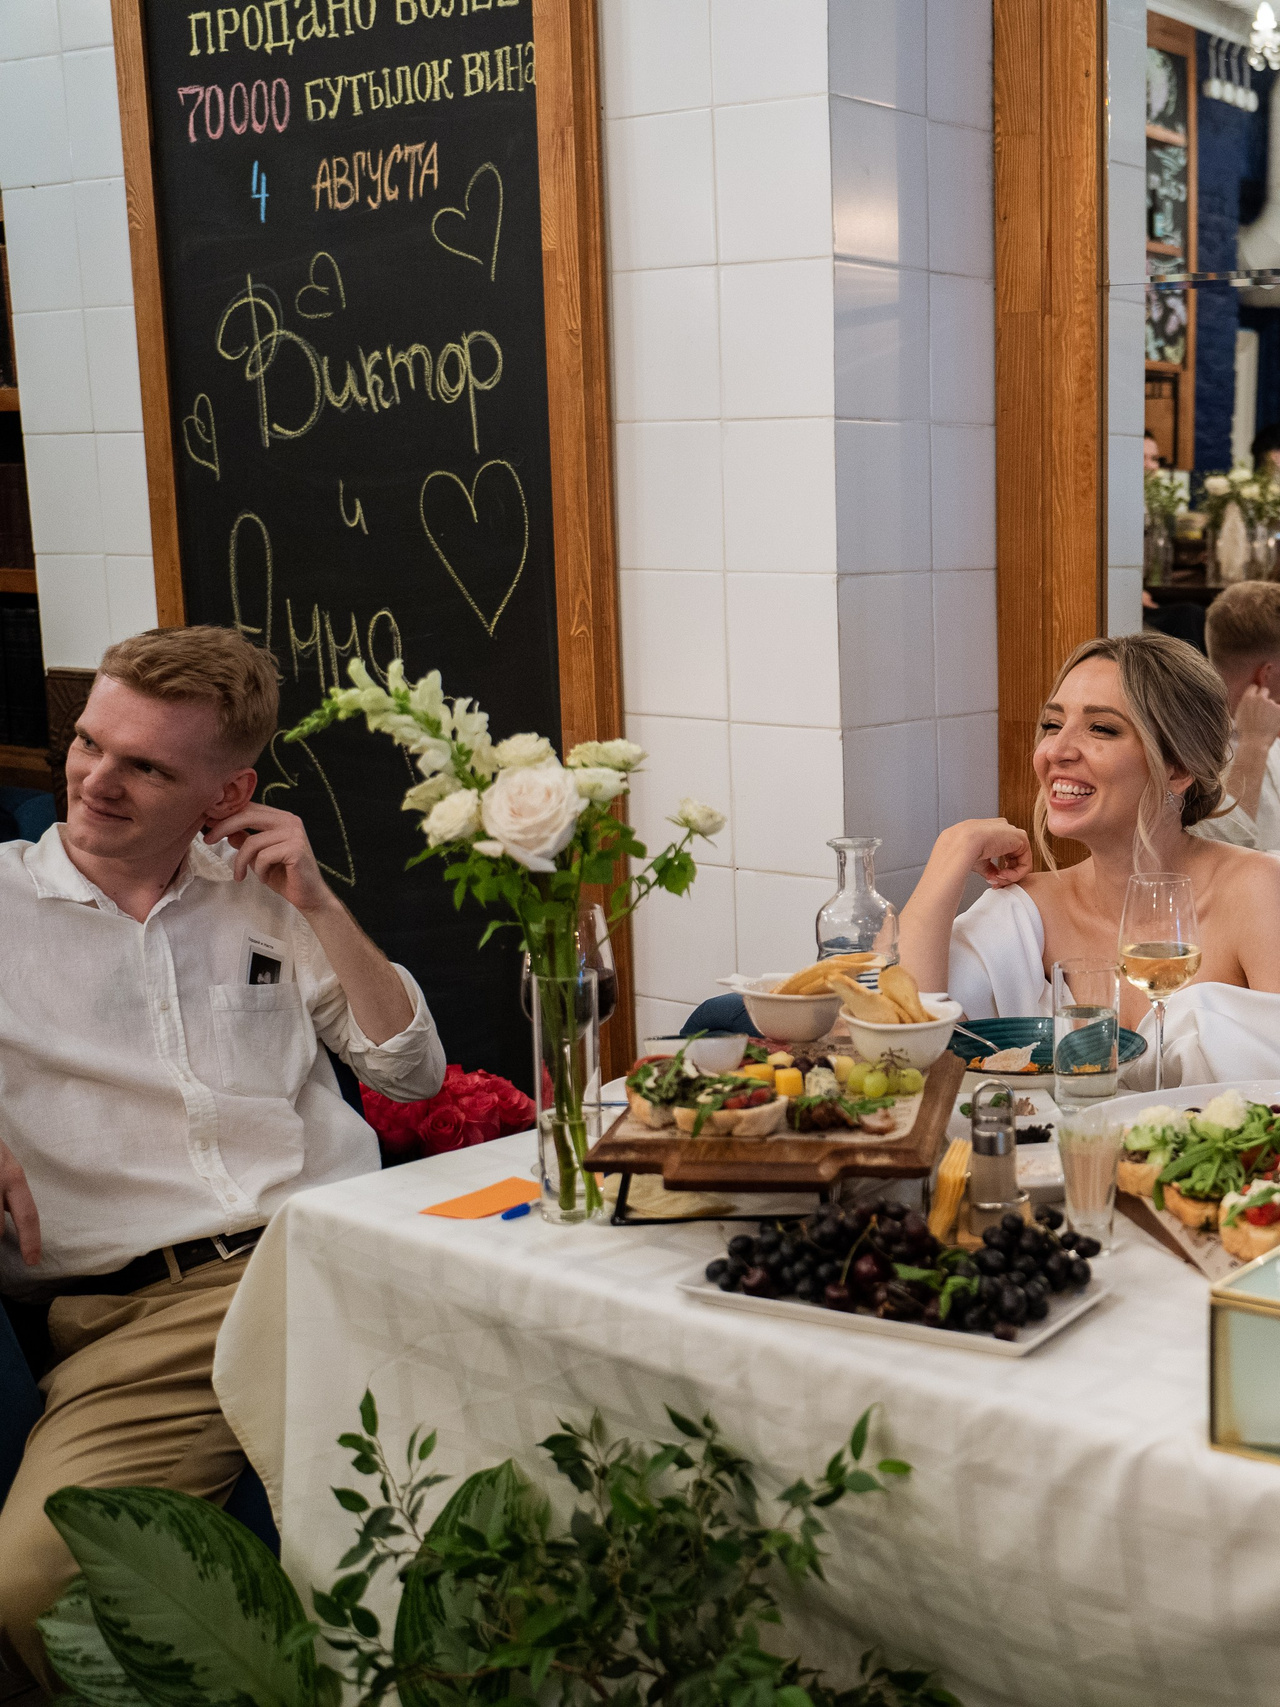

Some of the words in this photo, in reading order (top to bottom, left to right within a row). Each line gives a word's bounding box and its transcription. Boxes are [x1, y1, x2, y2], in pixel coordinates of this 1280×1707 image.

[178, 78, 290, 143] 70000
[304, 59, 454, 122] БУТЫЛОК
[251, 161, 269, 223] 4
[312, 141, 439, 212] АВГУСТА
[216, 273, 503, 454] Виктор
